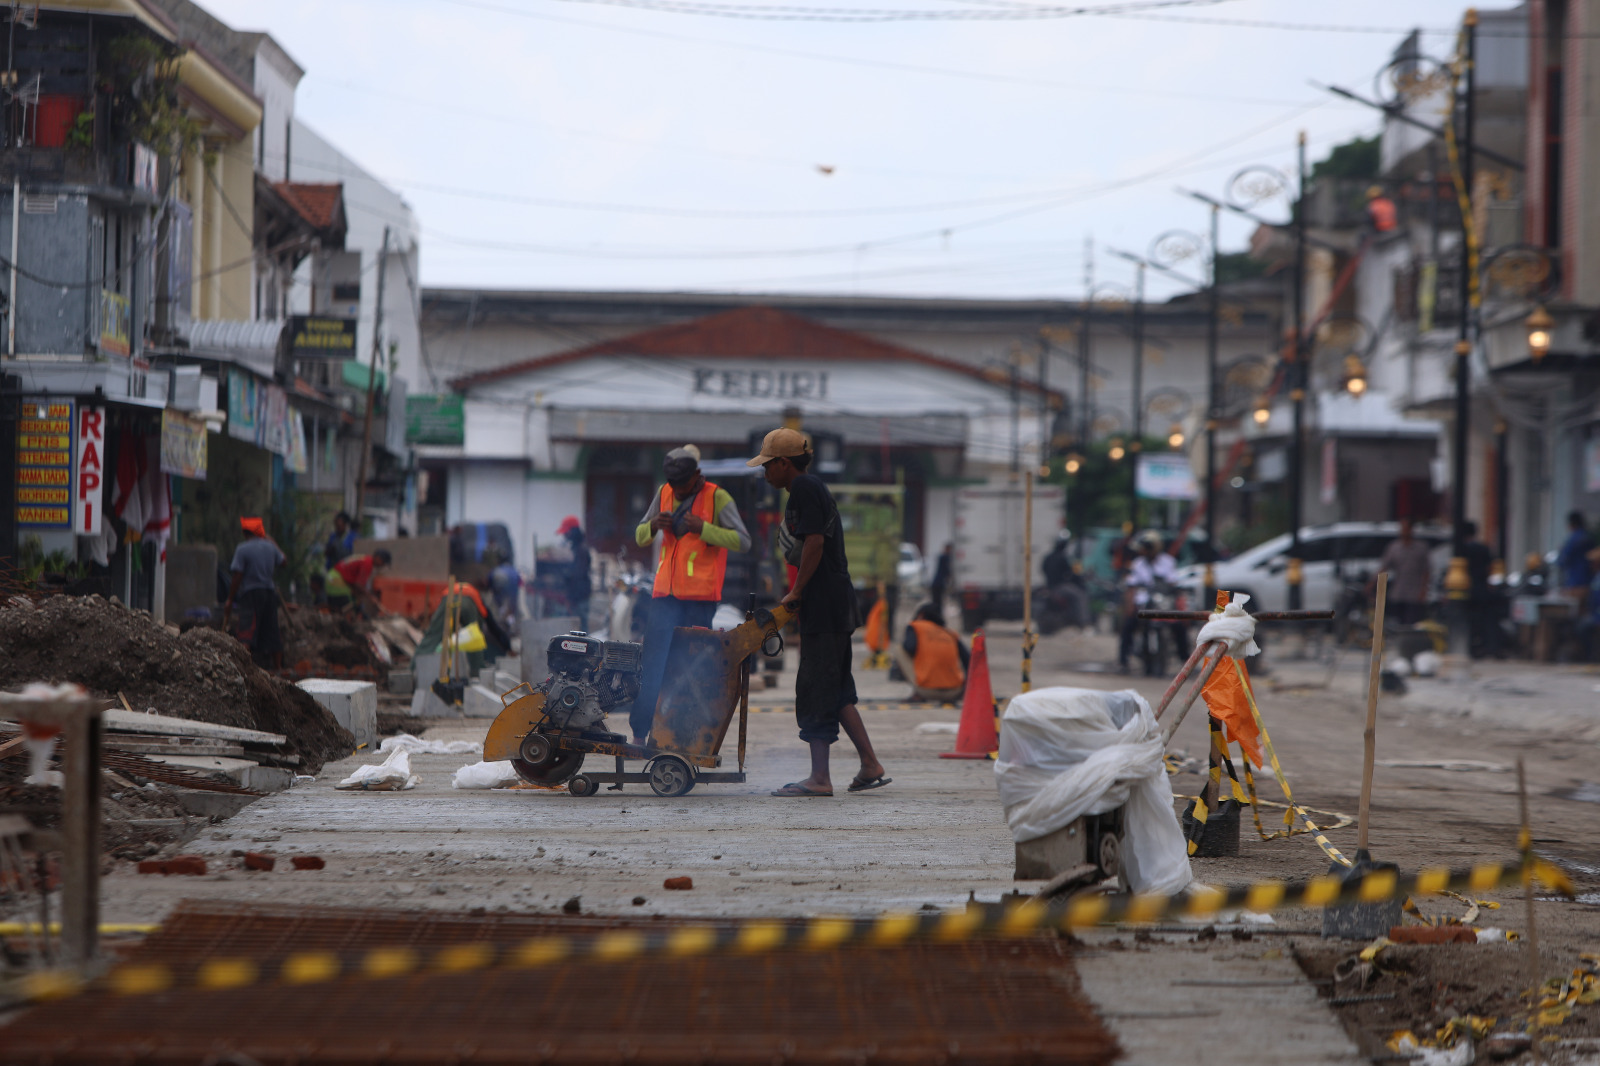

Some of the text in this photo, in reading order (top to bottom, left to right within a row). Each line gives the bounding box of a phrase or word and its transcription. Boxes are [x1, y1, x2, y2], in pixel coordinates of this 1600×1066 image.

[693, 368, 830, 398] KEDIRI
[20, 419, 68, 434] SEKOLAH
[27, 435, 60, 448] PNS
[19, 451, 68, 465] STEMPEL
[79, 409, 102, 533] RAPI
[18, 506, 67, 523] VANDEL
